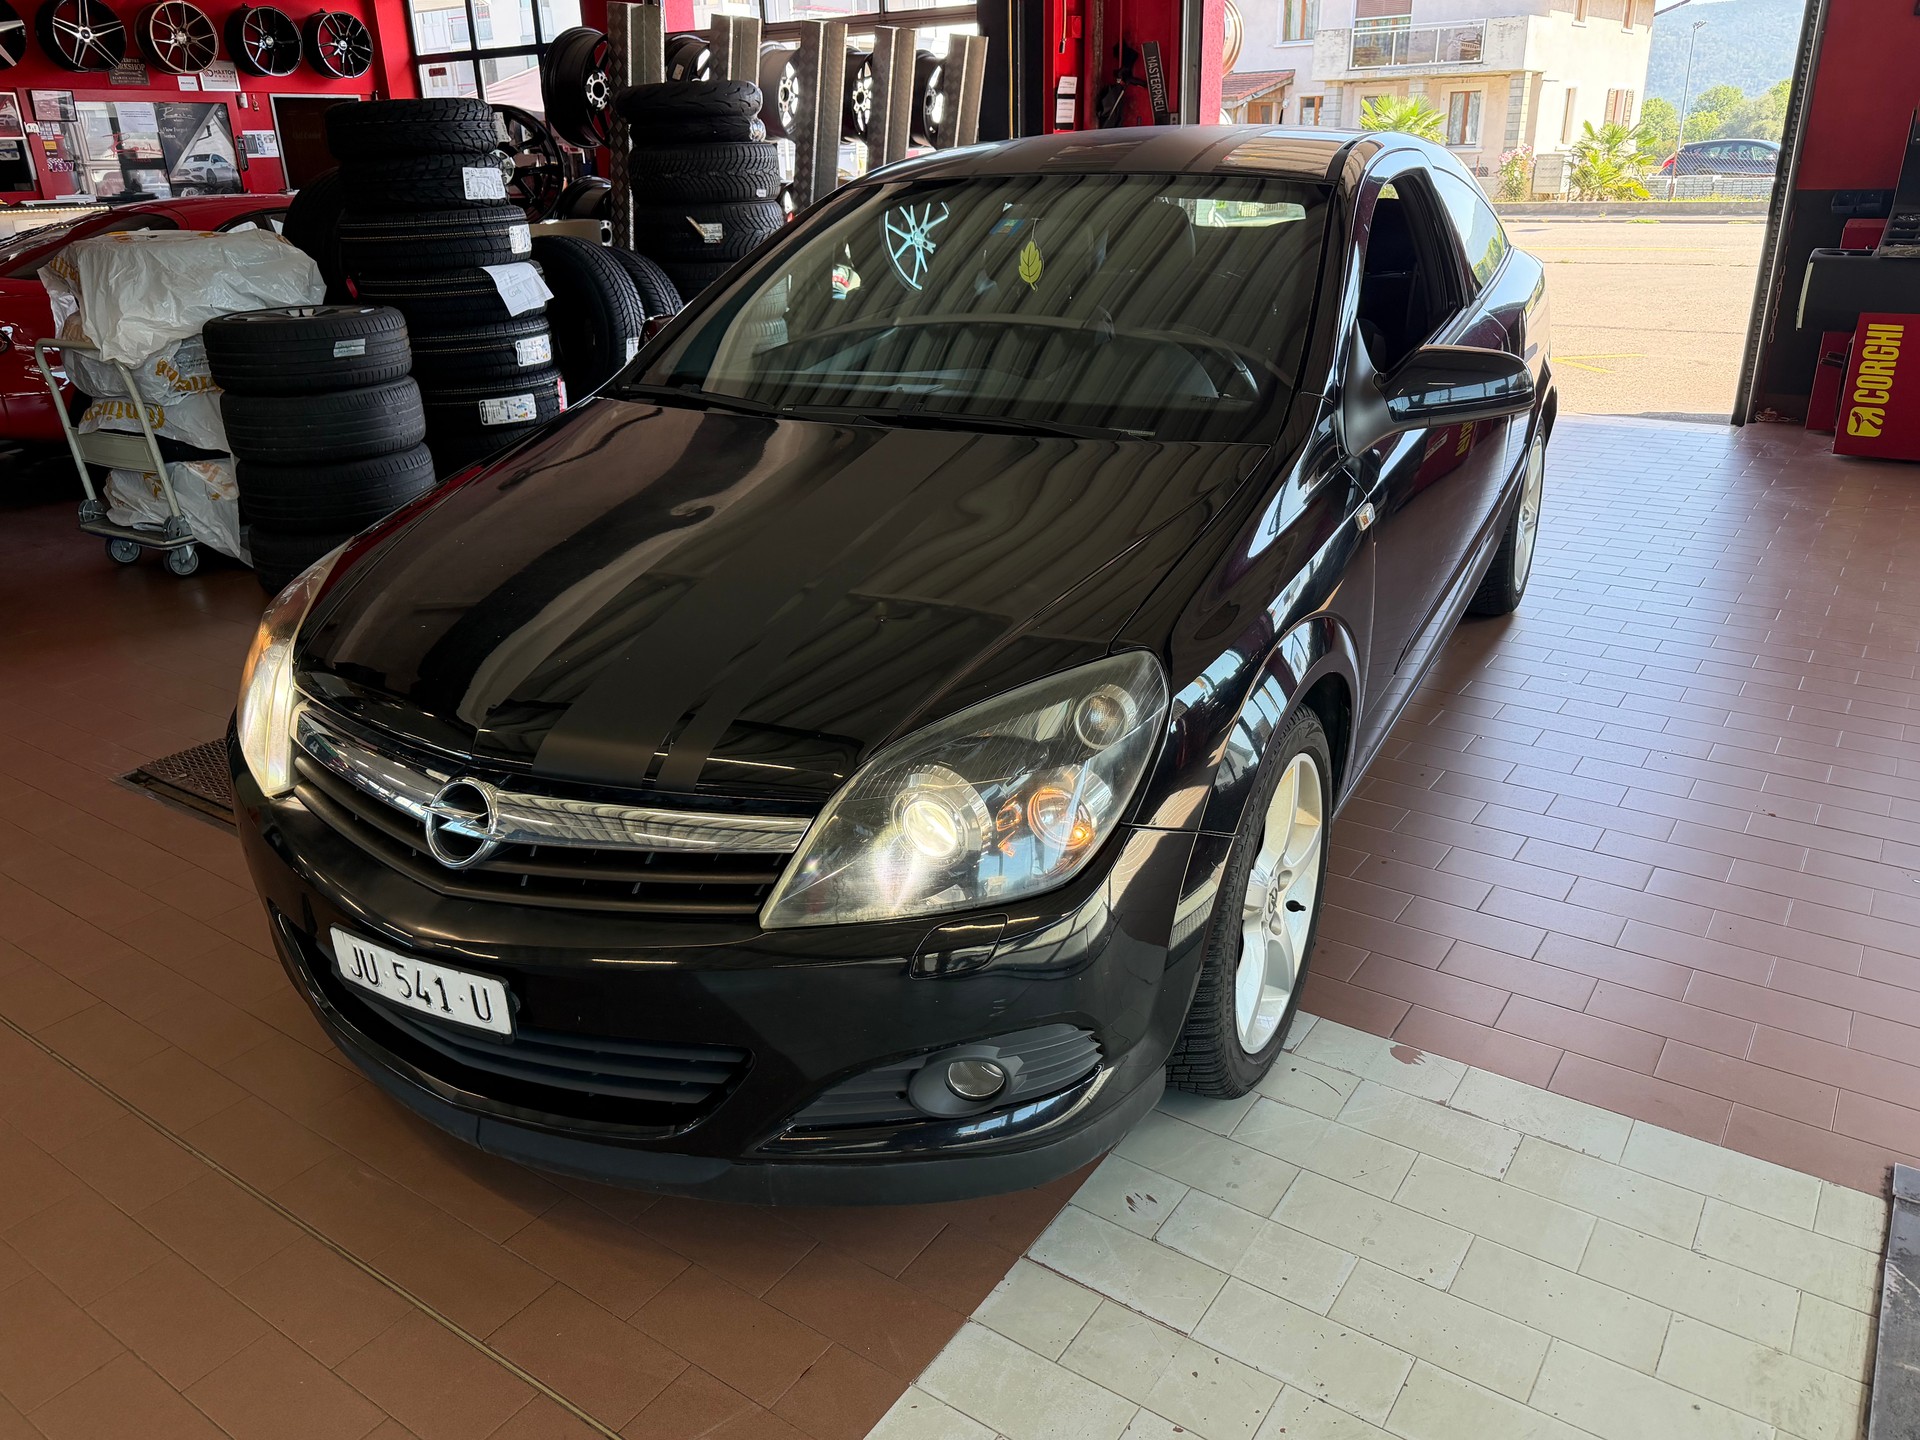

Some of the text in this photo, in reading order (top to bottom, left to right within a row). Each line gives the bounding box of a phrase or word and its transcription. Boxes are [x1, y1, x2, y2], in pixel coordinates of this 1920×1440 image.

[1147, 55, 1165, 112] MASTERPNEU
[1853, 323, 1904, 404] CORGHI
[350, 943, 493, 1022] JU 541 U
